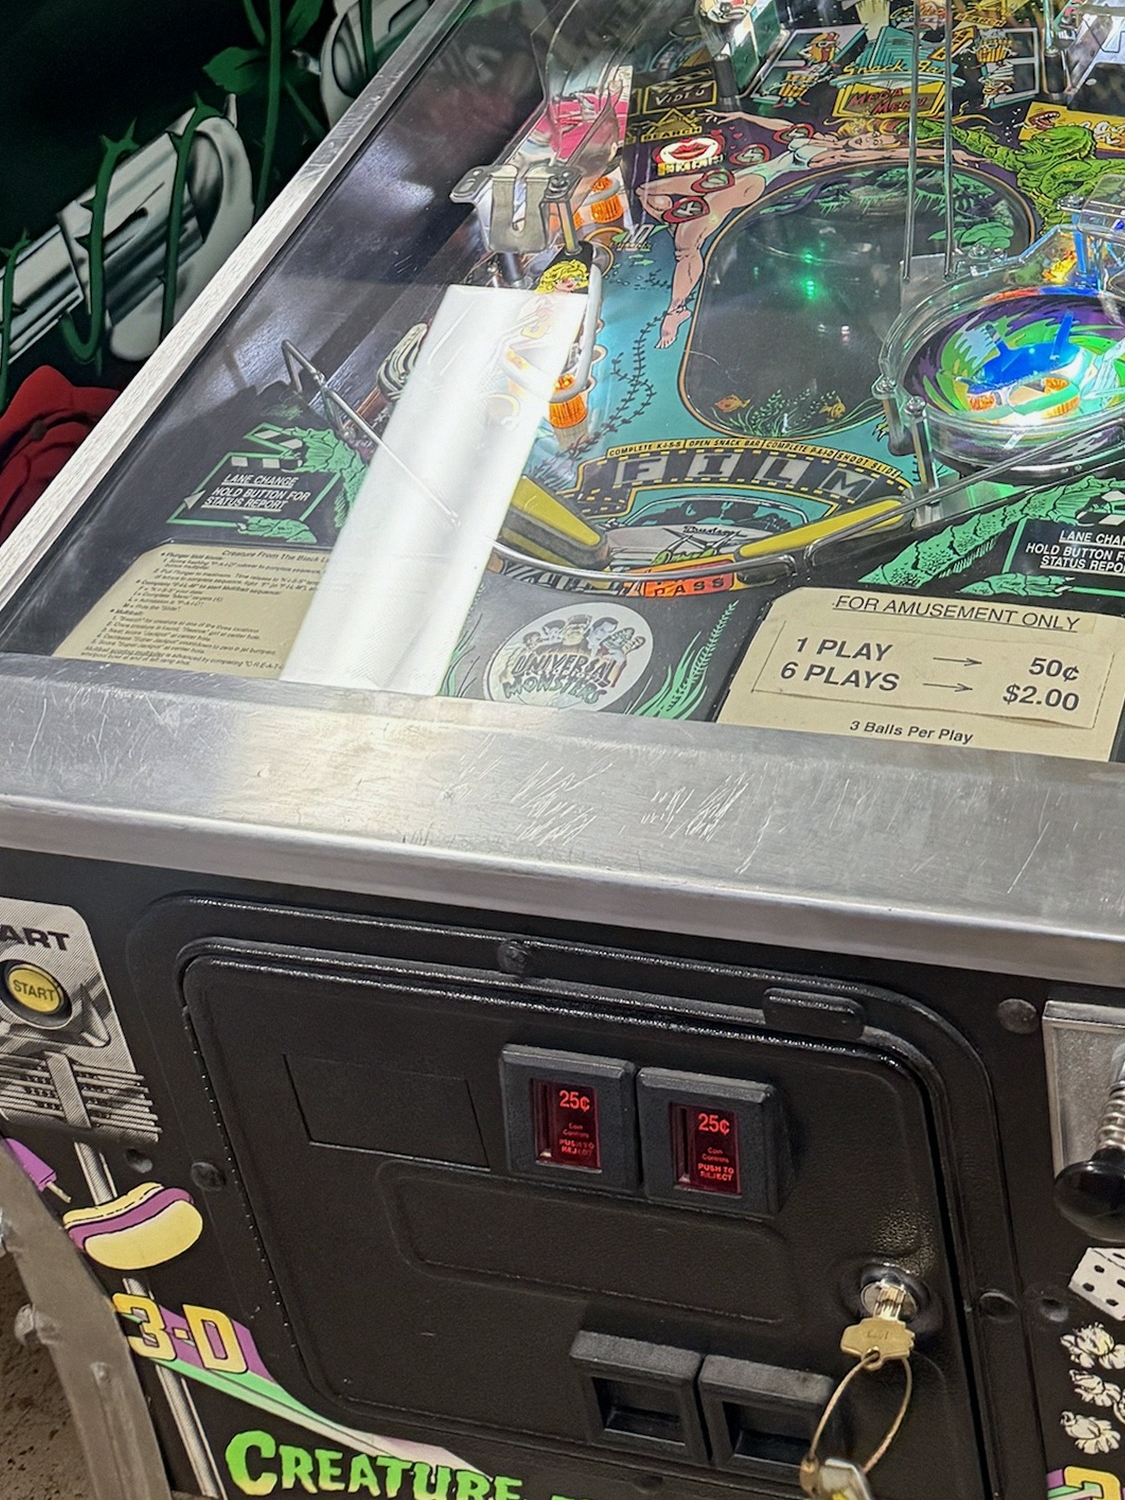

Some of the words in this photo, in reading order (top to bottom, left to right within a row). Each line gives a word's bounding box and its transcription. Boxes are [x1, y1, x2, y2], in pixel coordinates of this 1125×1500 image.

[842, 59, 907, 75] Snack
[608, 443, 655, 456] COMPLETE
[688, 439, 711, 448] OPEN
[713, 439, 743, 448] SNACK
[744, 439, 761, 449] BAR
[765, 441, 809, 453] COMPLETE
[836, 450, 869, 467] SHOOT
[869, 460, 902, 478] SLIDE
[223, 473, 253, 485] LANE
[253, 474, 299, 487] CHANGE
[204, 496, 246, 507] STATUS
[245, 499, 289, 510] REPORT
[212, 486, 243, 497] HOLD
[243, 488, 288, 500] BUTTON
[286, 491, 312, 502] FOR
[1059, 529, 1092, 543] LANE
[1025, 542, 1061, 556] HOLD
[1062, 545, 1114, 561] BUTTON
[1040, 555, 1088, 570] STATUS
[834, 594, 884, 615] FOR
[888, 598, 1017, 628] AMUSEMENT
[1021, 611, 1081, 634] ONLY
[513, 652, 618, 688] UNIVERSAL
[796, 636, 807, 656] 1
[815, 637, 894, 663] PLAY
[1028, 656, 1081, 682] 50¢
[502, 673, 608, 704] MONSTERS
[779, 660, 797, 681] 6
[803, 663, 900, 693] PLAYS
[1001, 682, 1080, 713] $2.00
[849, 720, 860, 732] 3
[863, 720, 904, 738] Balls
[906, 725, 933, 741] Per
[937, 728, 974, 746] Play
[12, 979, 55, 1002] START
[559, 1089, 591, 1113] 25¢
[698, 1112, 731, 1137] 25¢
[707, 1146, 724, 1156] Coin
[698, 1162, 722, 1173] PUSH
[722, 1165, 735, 1175] TO
[112, 1292, 249, 1374] 3-D
[224, 1429, 523, 1500] CREATURE
